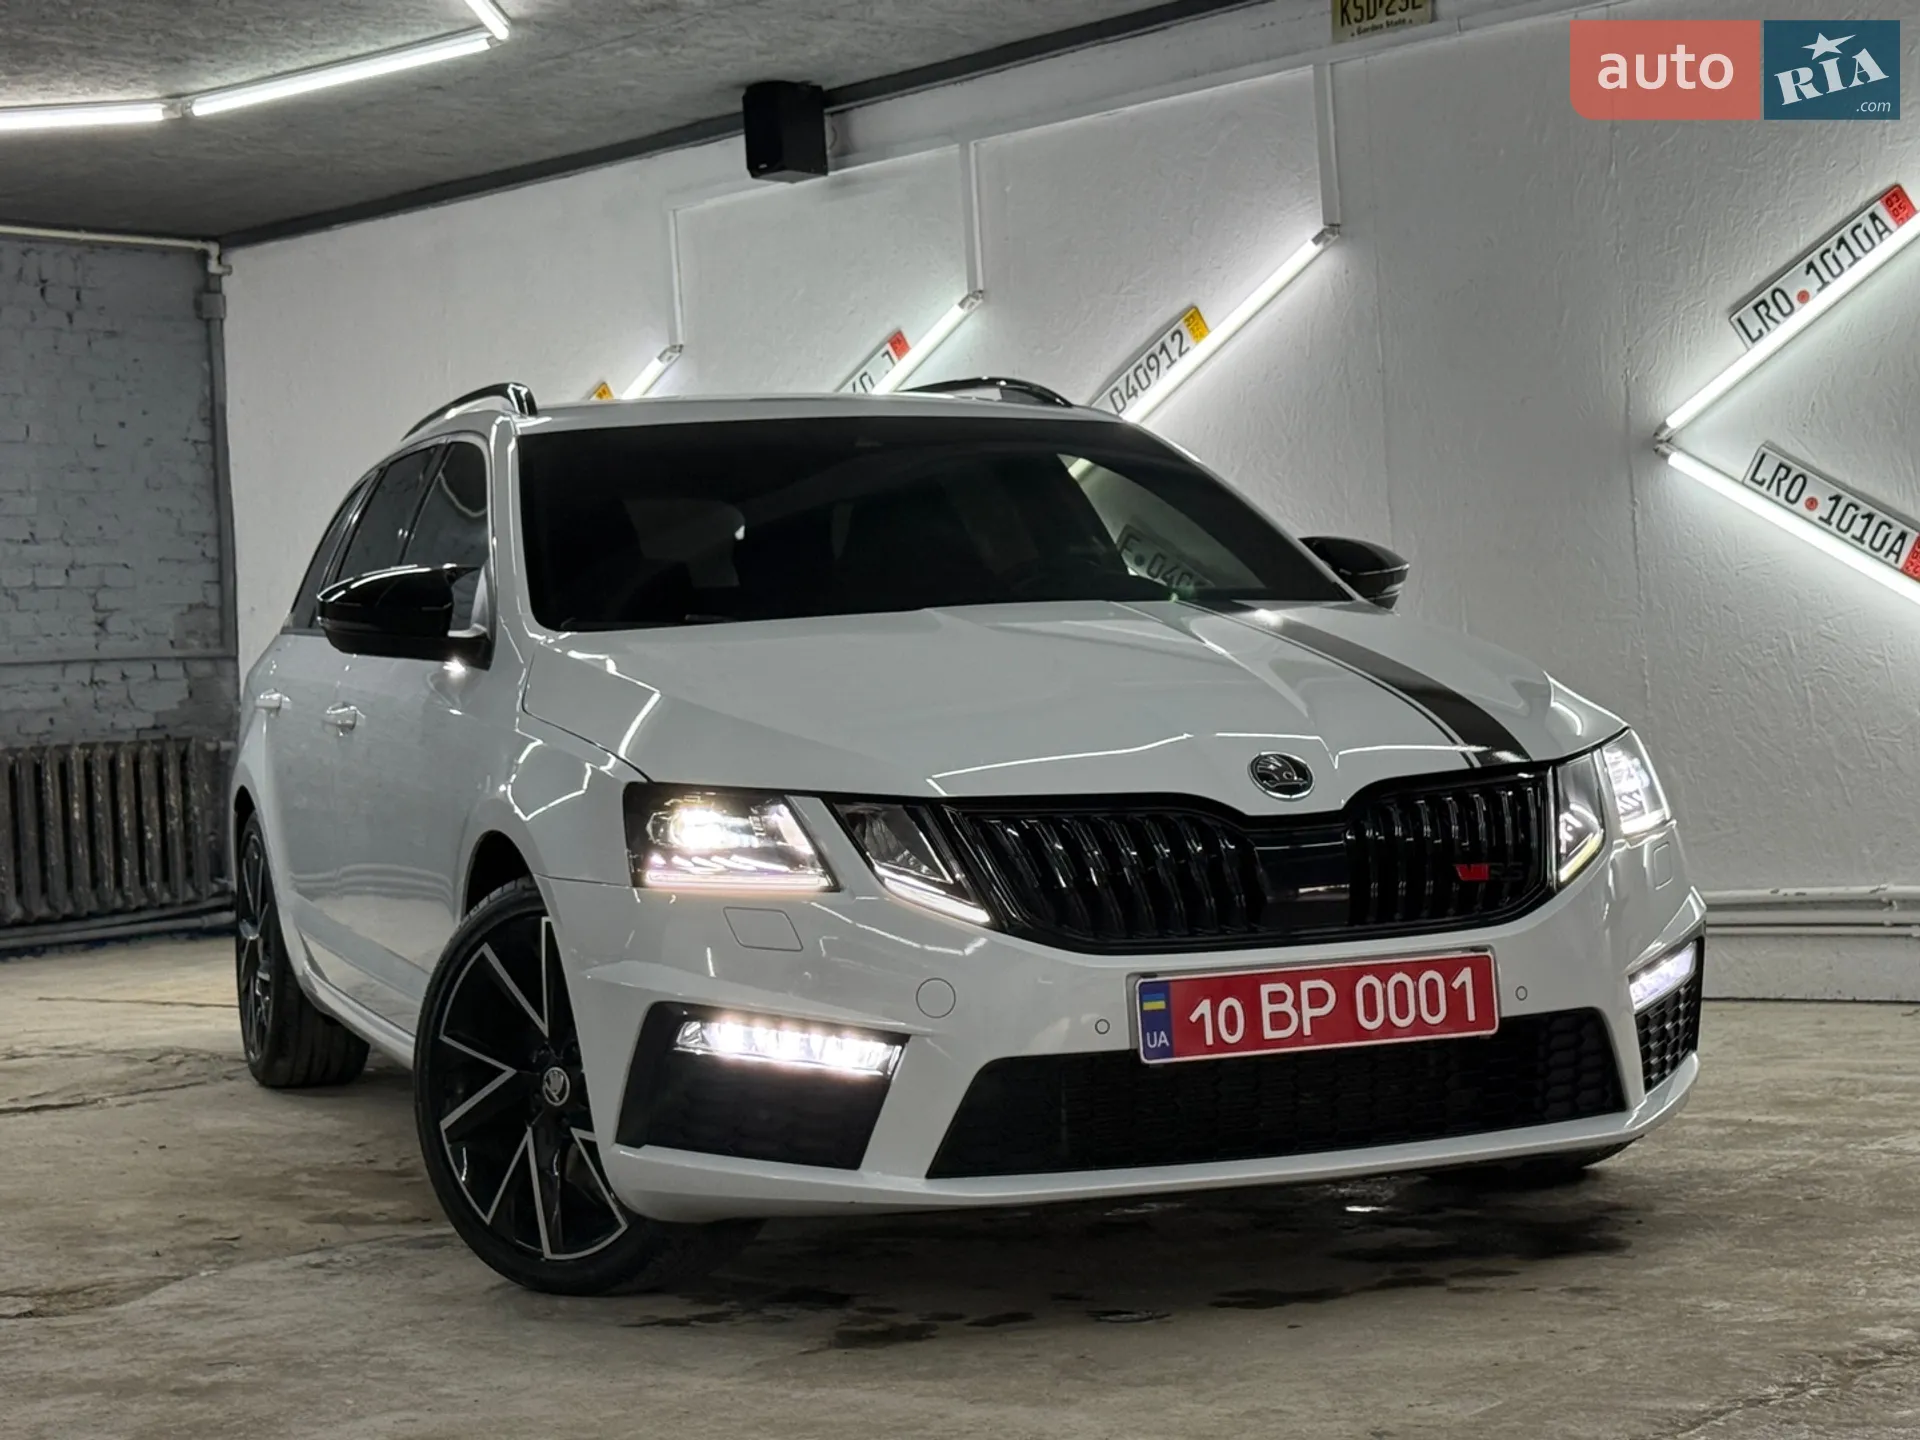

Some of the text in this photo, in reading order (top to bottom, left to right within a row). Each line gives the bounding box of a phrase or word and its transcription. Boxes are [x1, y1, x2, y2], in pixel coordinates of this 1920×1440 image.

[1109, 329, 1190, 414] 040912
[1750, 453, 1909, 564] LRO 1010A
[1146, 1031, 1170, 1048] UA
[1189, 966, 1476, 1046] 10 BP 0001
